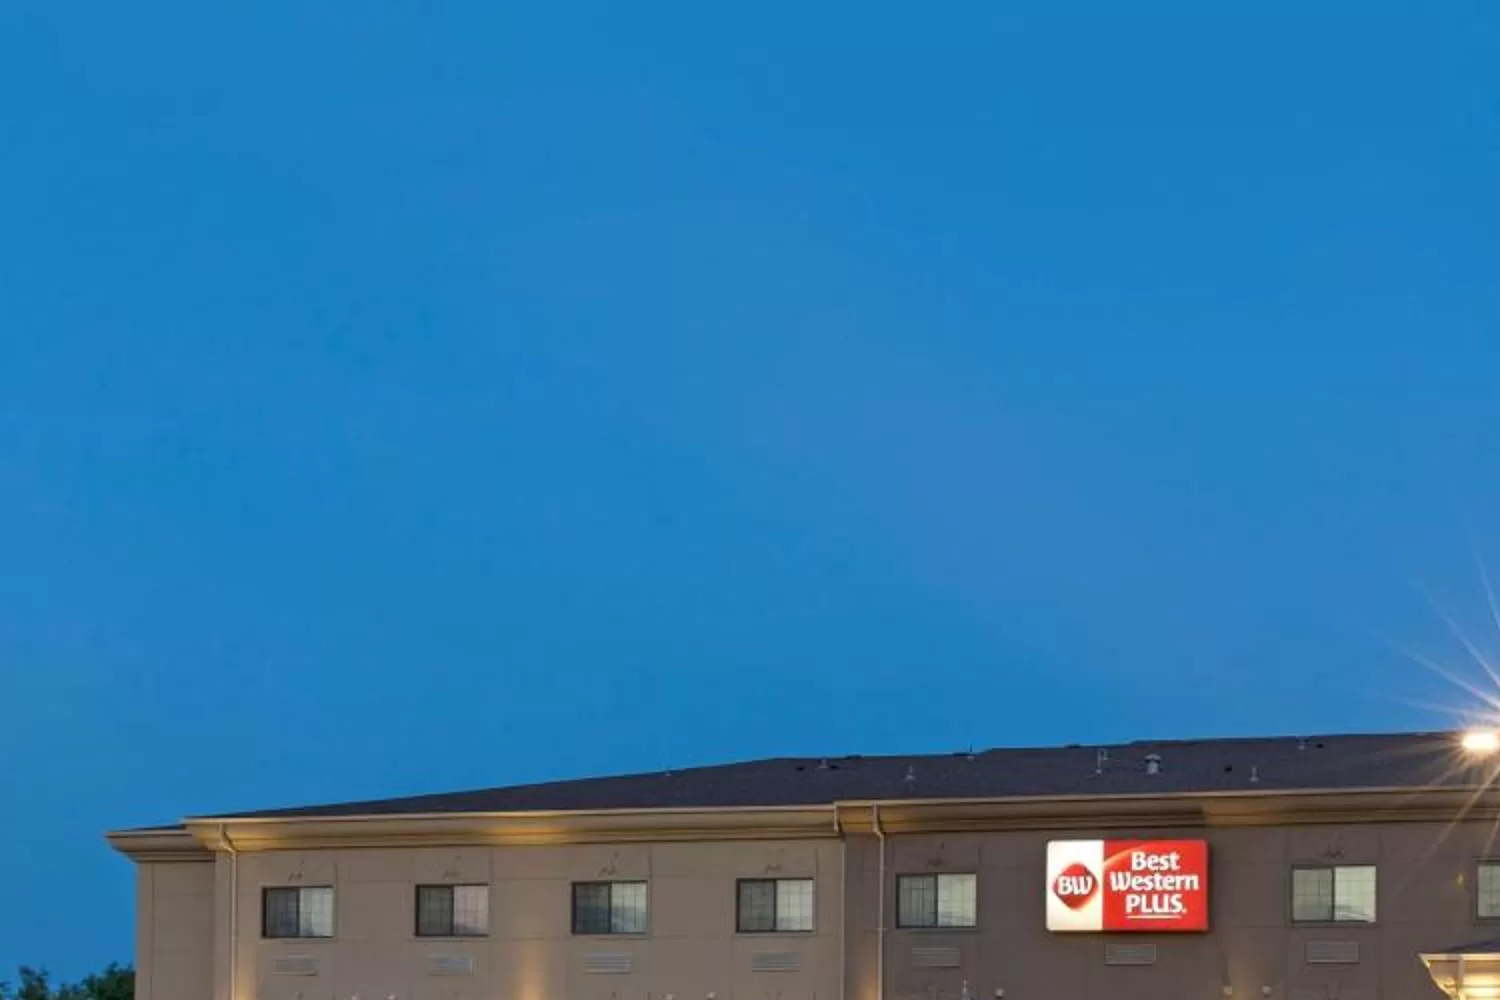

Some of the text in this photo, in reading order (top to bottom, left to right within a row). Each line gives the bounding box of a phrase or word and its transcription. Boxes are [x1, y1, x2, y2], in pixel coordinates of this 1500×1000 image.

[1131, 851, 1180, 871] Best
[1058, 875, 1092, 895] BW
[1109, 872, 1199, 891] Western
